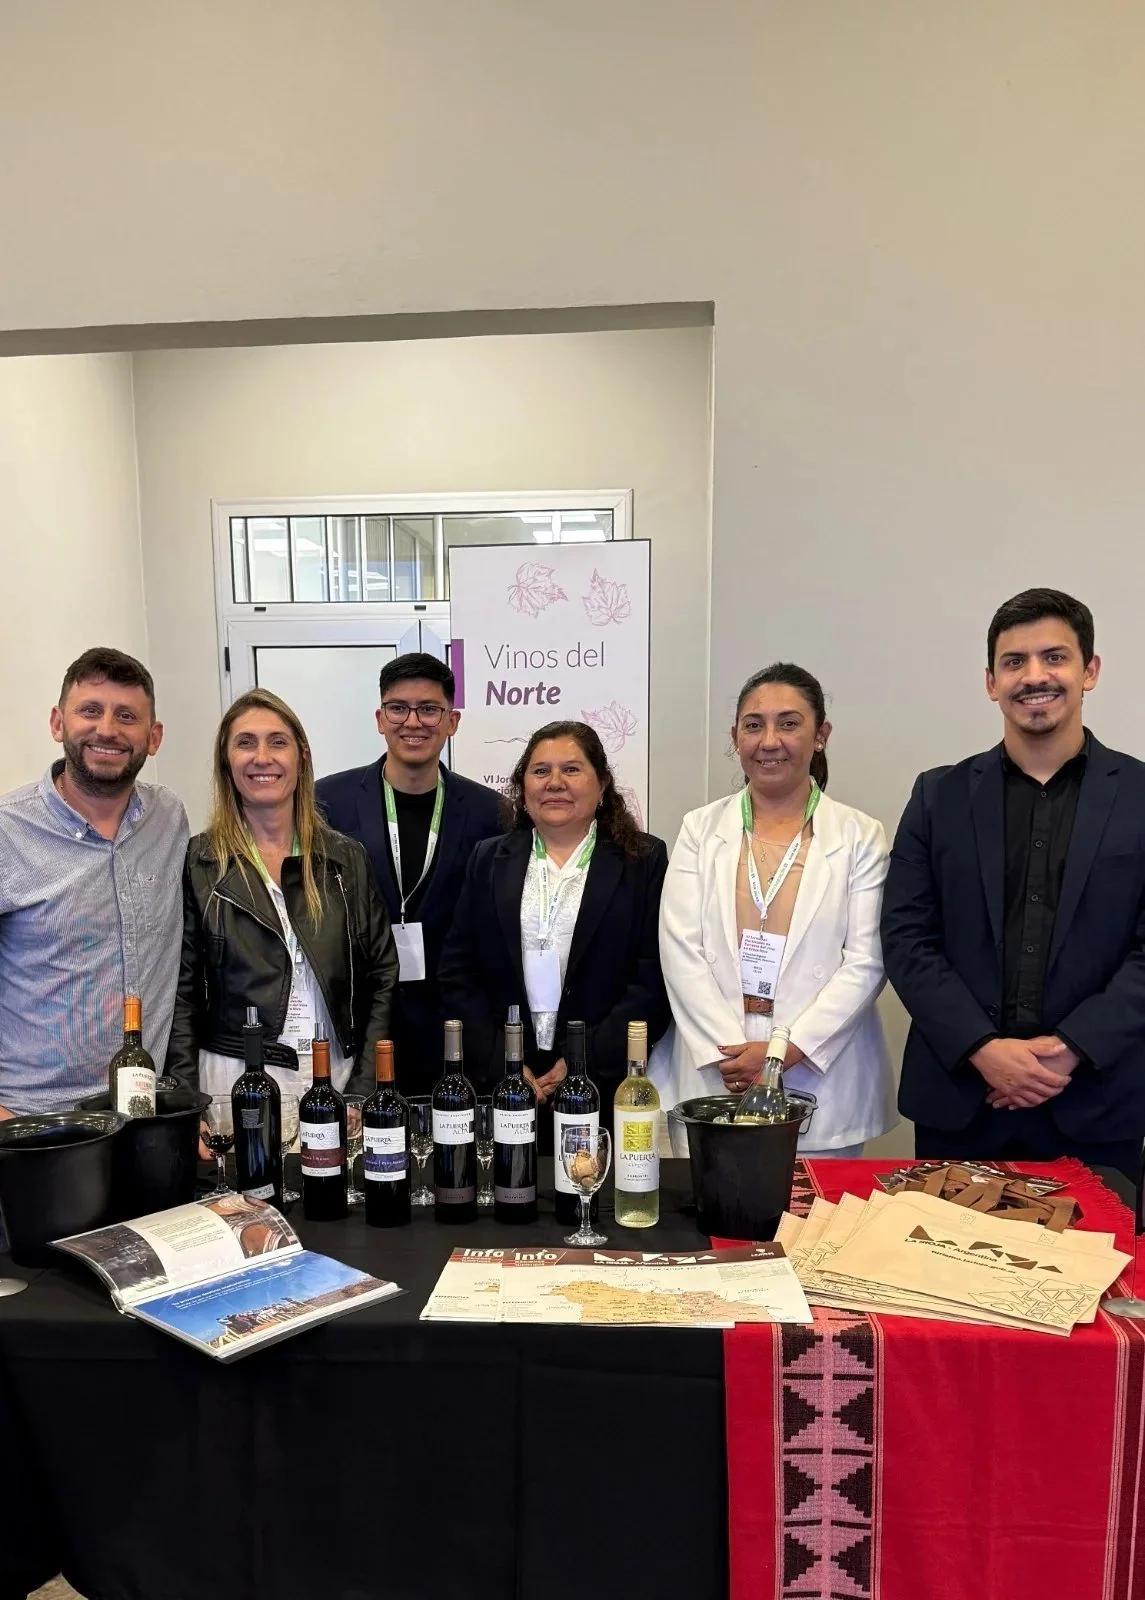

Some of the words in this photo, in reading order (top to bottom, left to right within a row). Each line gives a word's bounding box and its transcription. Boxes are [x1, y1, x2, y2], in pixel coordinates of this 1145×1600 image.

[484, 643, 558, 669] Vinos
[565, 641, 605, 668] del
[485, 680, 561, 706] Norte
[483, 775, 494, 784] VI
[463, 1248, 505, 1258] Info
[514, 1250, 557, 1261] Info
[953, 1248, 998, 1263] Argentina
